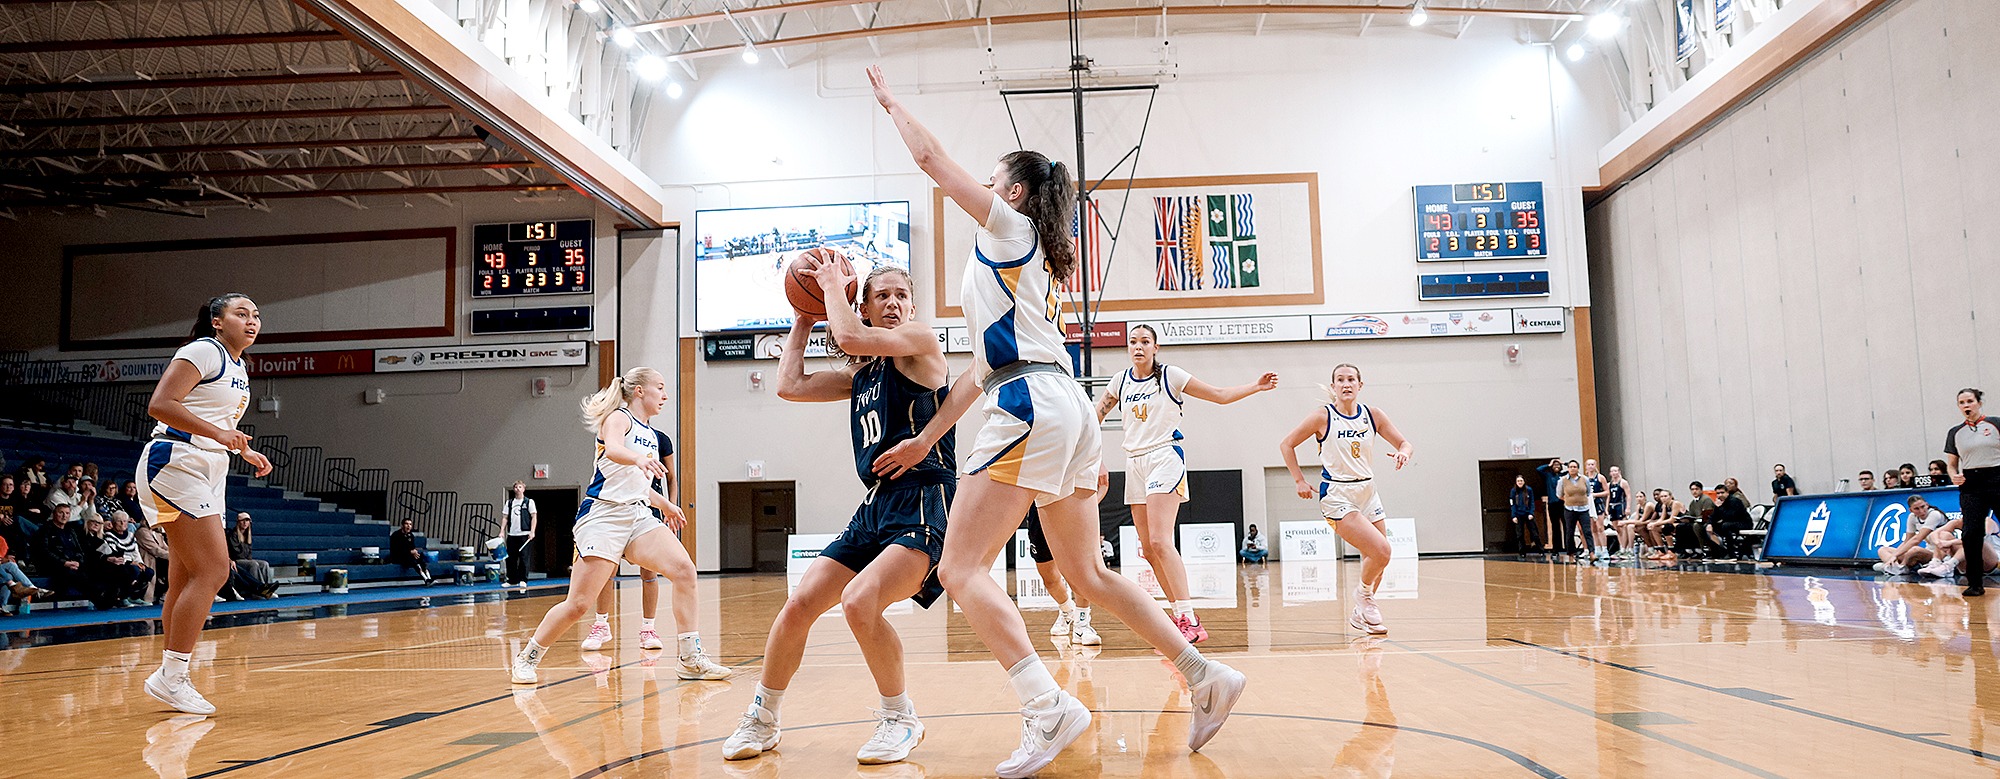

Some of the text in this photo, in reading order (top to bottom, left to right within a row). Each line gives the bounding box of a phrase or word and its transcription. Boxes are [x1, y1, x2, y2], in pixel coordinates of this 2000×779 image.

[1472, 184, 1504, 200] 1:51
[1426, 204, 1448, 213] HOME
[1511, 201, 1536, 210] GUEST
[1430, 214, 1452, 230] 43
[1477, 214, 1486, 228] 3
[1517, 211, 1538, 228] 35
[527, 223, 555, 240] 1:51
[483, 243, 503, 251] HOME
[559, 239, 582, 248] GUEST
[1430, 237, 1439, 251] 2
[1450, 237, 1458, 251] 3
[1476, 236, 1499, 250] 2 3
[1507, 235, 1517, 249] 3
[1531, 234, 1539, 248] 3
[484, 252, 505, 269] 43
[528, 252, 537, 266] 3
[565, 249, 585, 265] 35
[484, 275, 493, 289] 2
[501, 274, 510, 288] 3
[525, 273, 547, 287] 2 3
[555, 272, 563, 286] 3
[576, 271, 584, 285] 3
[1161, 323, 1274, 337] VARSITY LETTERS
[809, 338, 826, 347] ME
[430, 349, 526, 361] PRESTON
[529, 350, 558, 358] GMC
[122, 363, 164, 376] COUNTRY
[304, 357, 315, 370] it
[855, 382, 881, 412] TWU
[1125, 392, 1153, 403] HEAT
[860, 410, 881, 448] 10
[1338, 429, 1368, 438] HEAT
[1914, 476, 1932, 485] POSS
[1285, 527, 1330, 540] grounded.
